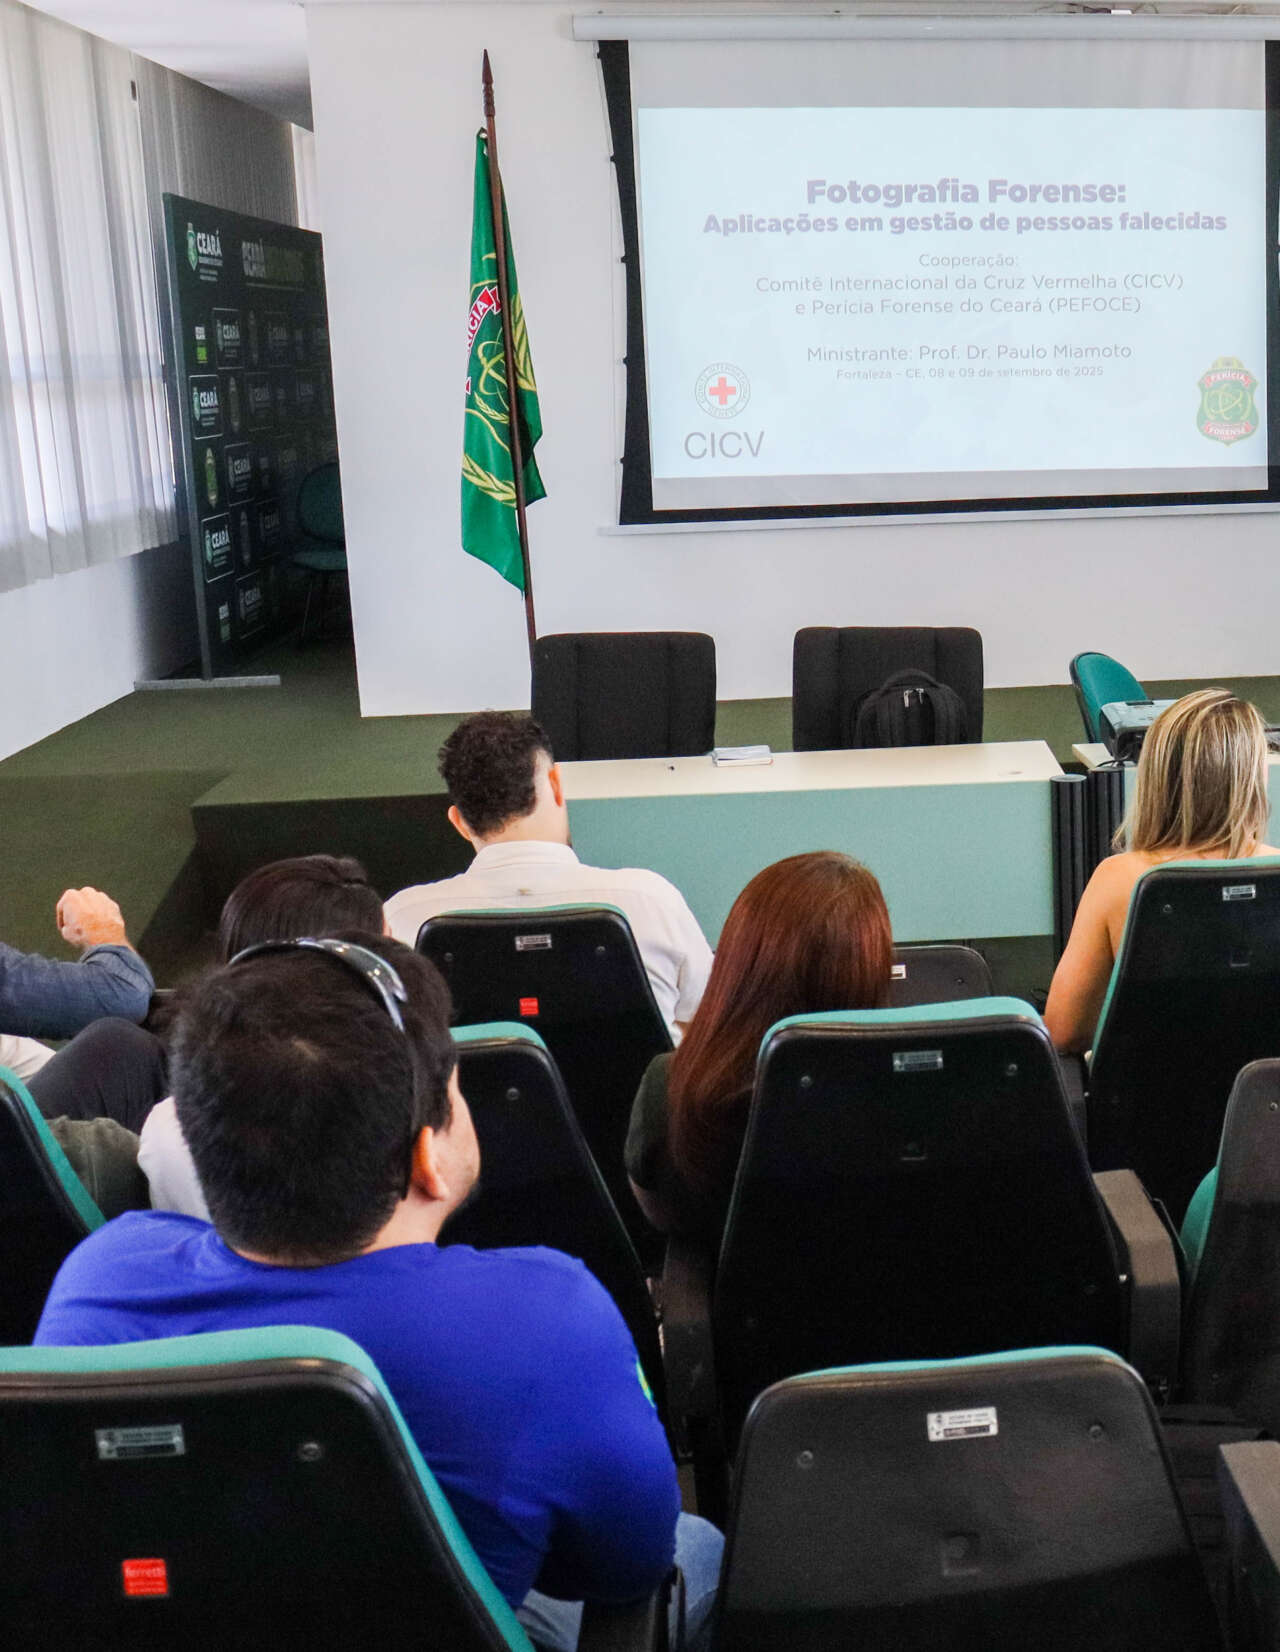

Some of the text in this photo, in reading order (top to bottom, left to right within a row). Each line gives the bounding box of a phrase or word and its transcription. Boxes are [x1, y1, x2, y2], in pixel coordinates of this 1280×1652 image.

[806, 176, 1127, 208] Fotografia Forense:
[702, 211, 1228, 237] Aplicações em gestão de pessoas falecidas
[918, 253, 1019, 270] Cooperação:
[755, 273, 1184, 292] Comitê Internacional da Cruz Vermelha (CICV)
[795, 296, 1142, 315] e Perícia Forense do Ceará (PEFOCE)
[807, 343, 1132, 362] Ministrante: Prof. Dr. Paulo Miamoto
[836, 369, 892, 380] Fortaleza
[929, 368, 945, 378] 08
[958, 367, 975, 378] 09
[978, 367, 994, 378] de
[1056, 367, 1071, 377] de
[1074, 366, 1104, 377] 2025
[684, 430, 765, 460] CICV
